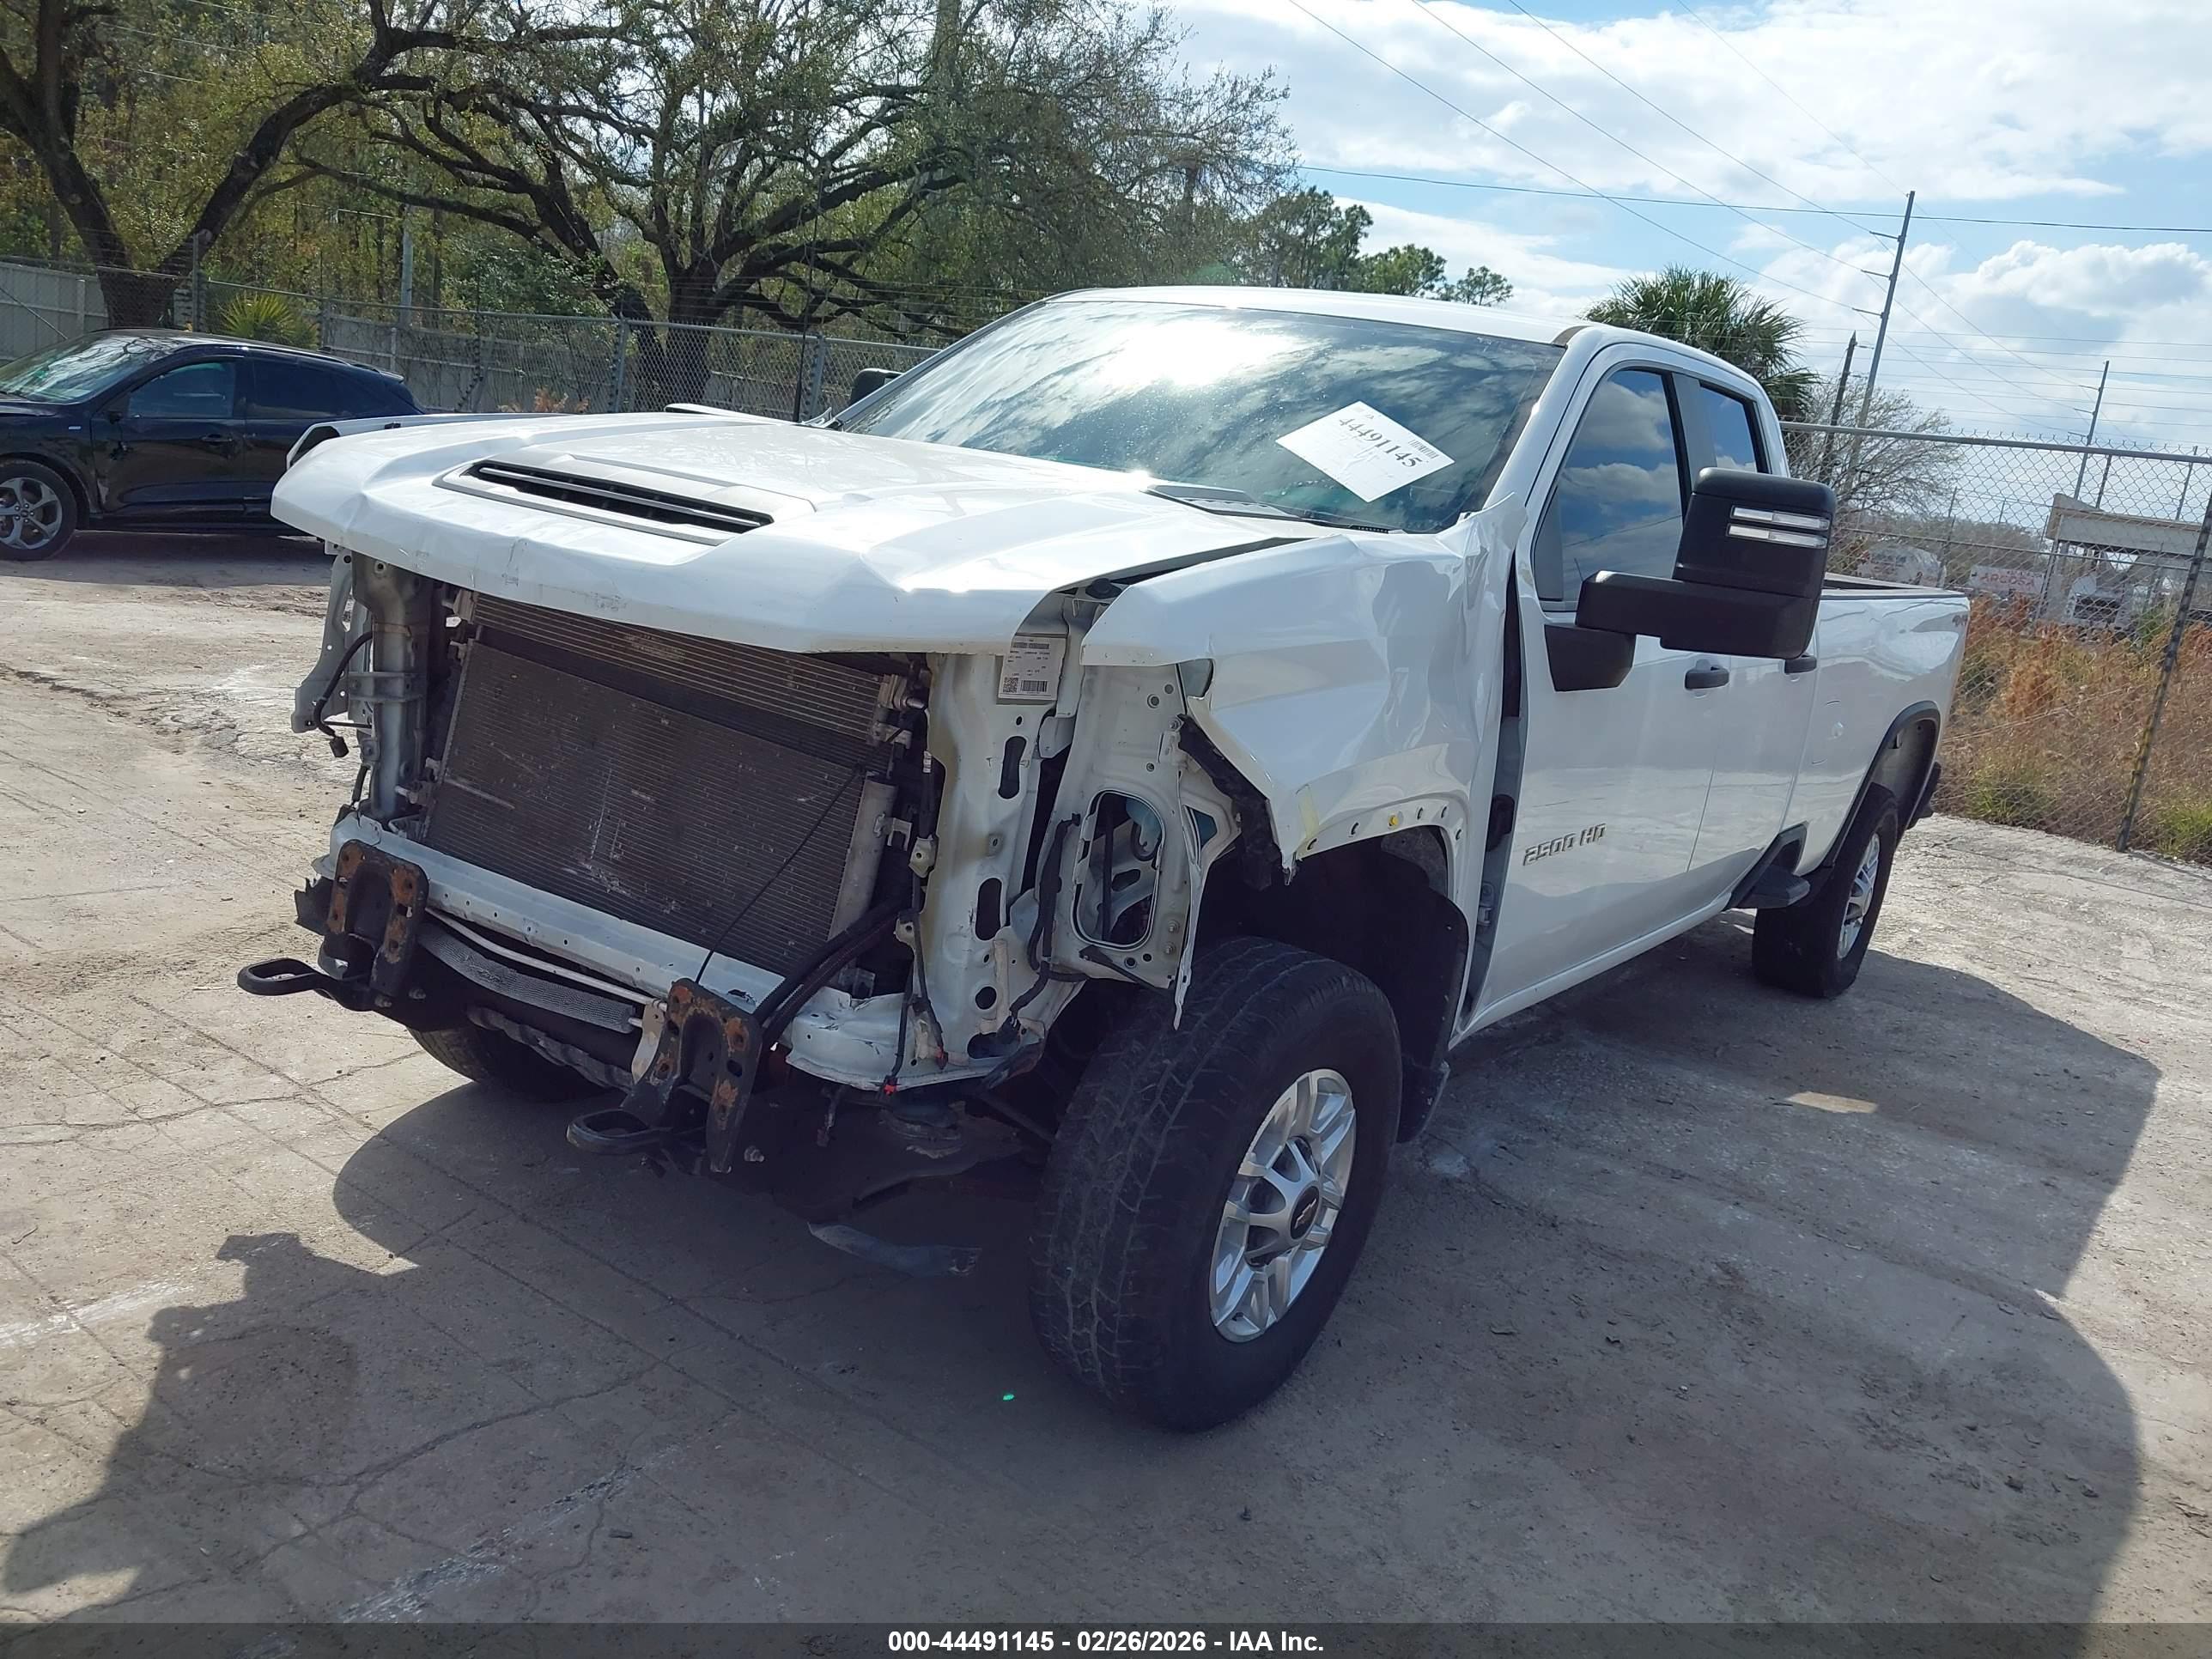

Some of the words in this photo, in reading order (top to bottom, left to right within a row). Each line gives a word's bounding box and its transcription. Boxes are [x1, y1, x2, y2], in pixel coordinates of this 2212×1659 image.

[1339, 418, 1423, 467] 44491145
[1522, 832, 1577, 866] 2500
[1579, 823, 1607, 847] HD
